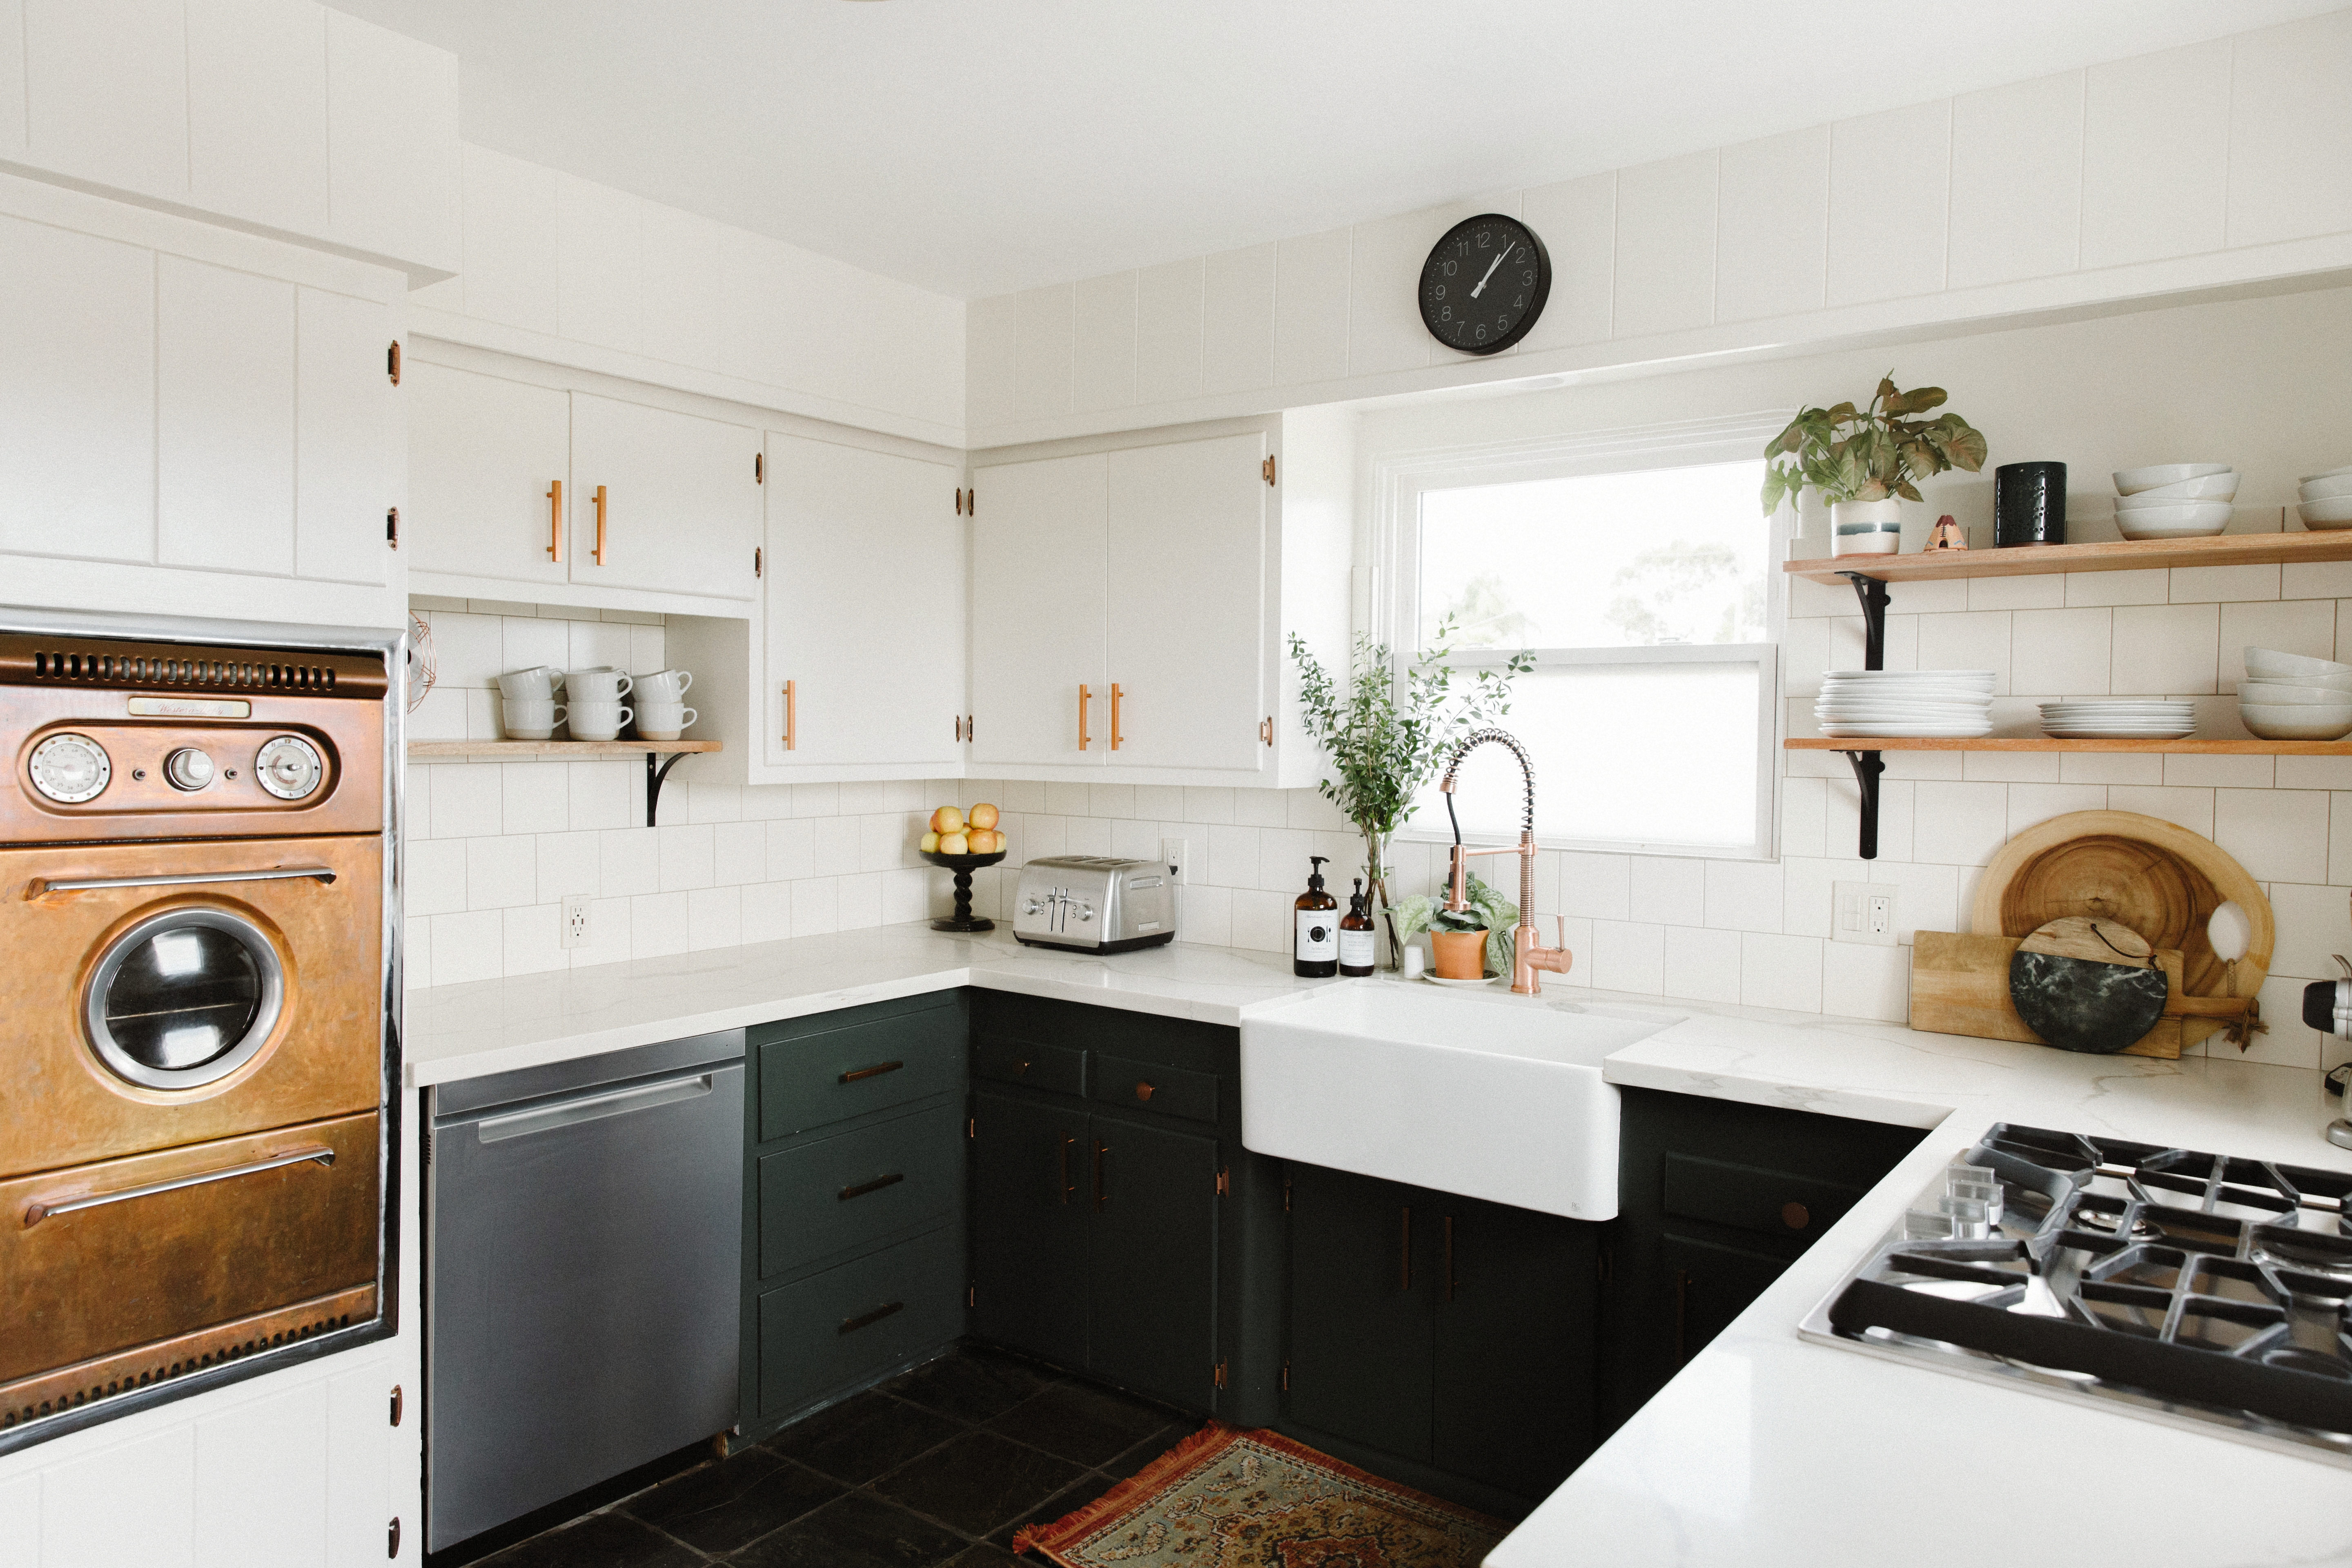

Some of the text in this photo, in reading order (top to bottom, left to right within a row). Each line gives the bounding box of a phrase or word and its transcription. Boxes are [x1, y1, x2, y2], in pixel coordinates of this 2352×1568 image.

[1475, 232, 1490, 248] 12
[1501, 234, 1506, 248] 1
[1457, 241, 1468, 256] 11
[1515, 247, 1526, 264] 2
[1441, 261, 1457, 276] 10
[1522, 270, 1532, 286] 3
[1436, 285, 1446, 300] 9
[1513, 295, 1523, 310] 4
[1441, 306, 1451, 321] 8
[1456, 321, 1465, 336] 7
[1498, 315, 1508, 330] 5
[1476, 324, 1486, 339] 6
